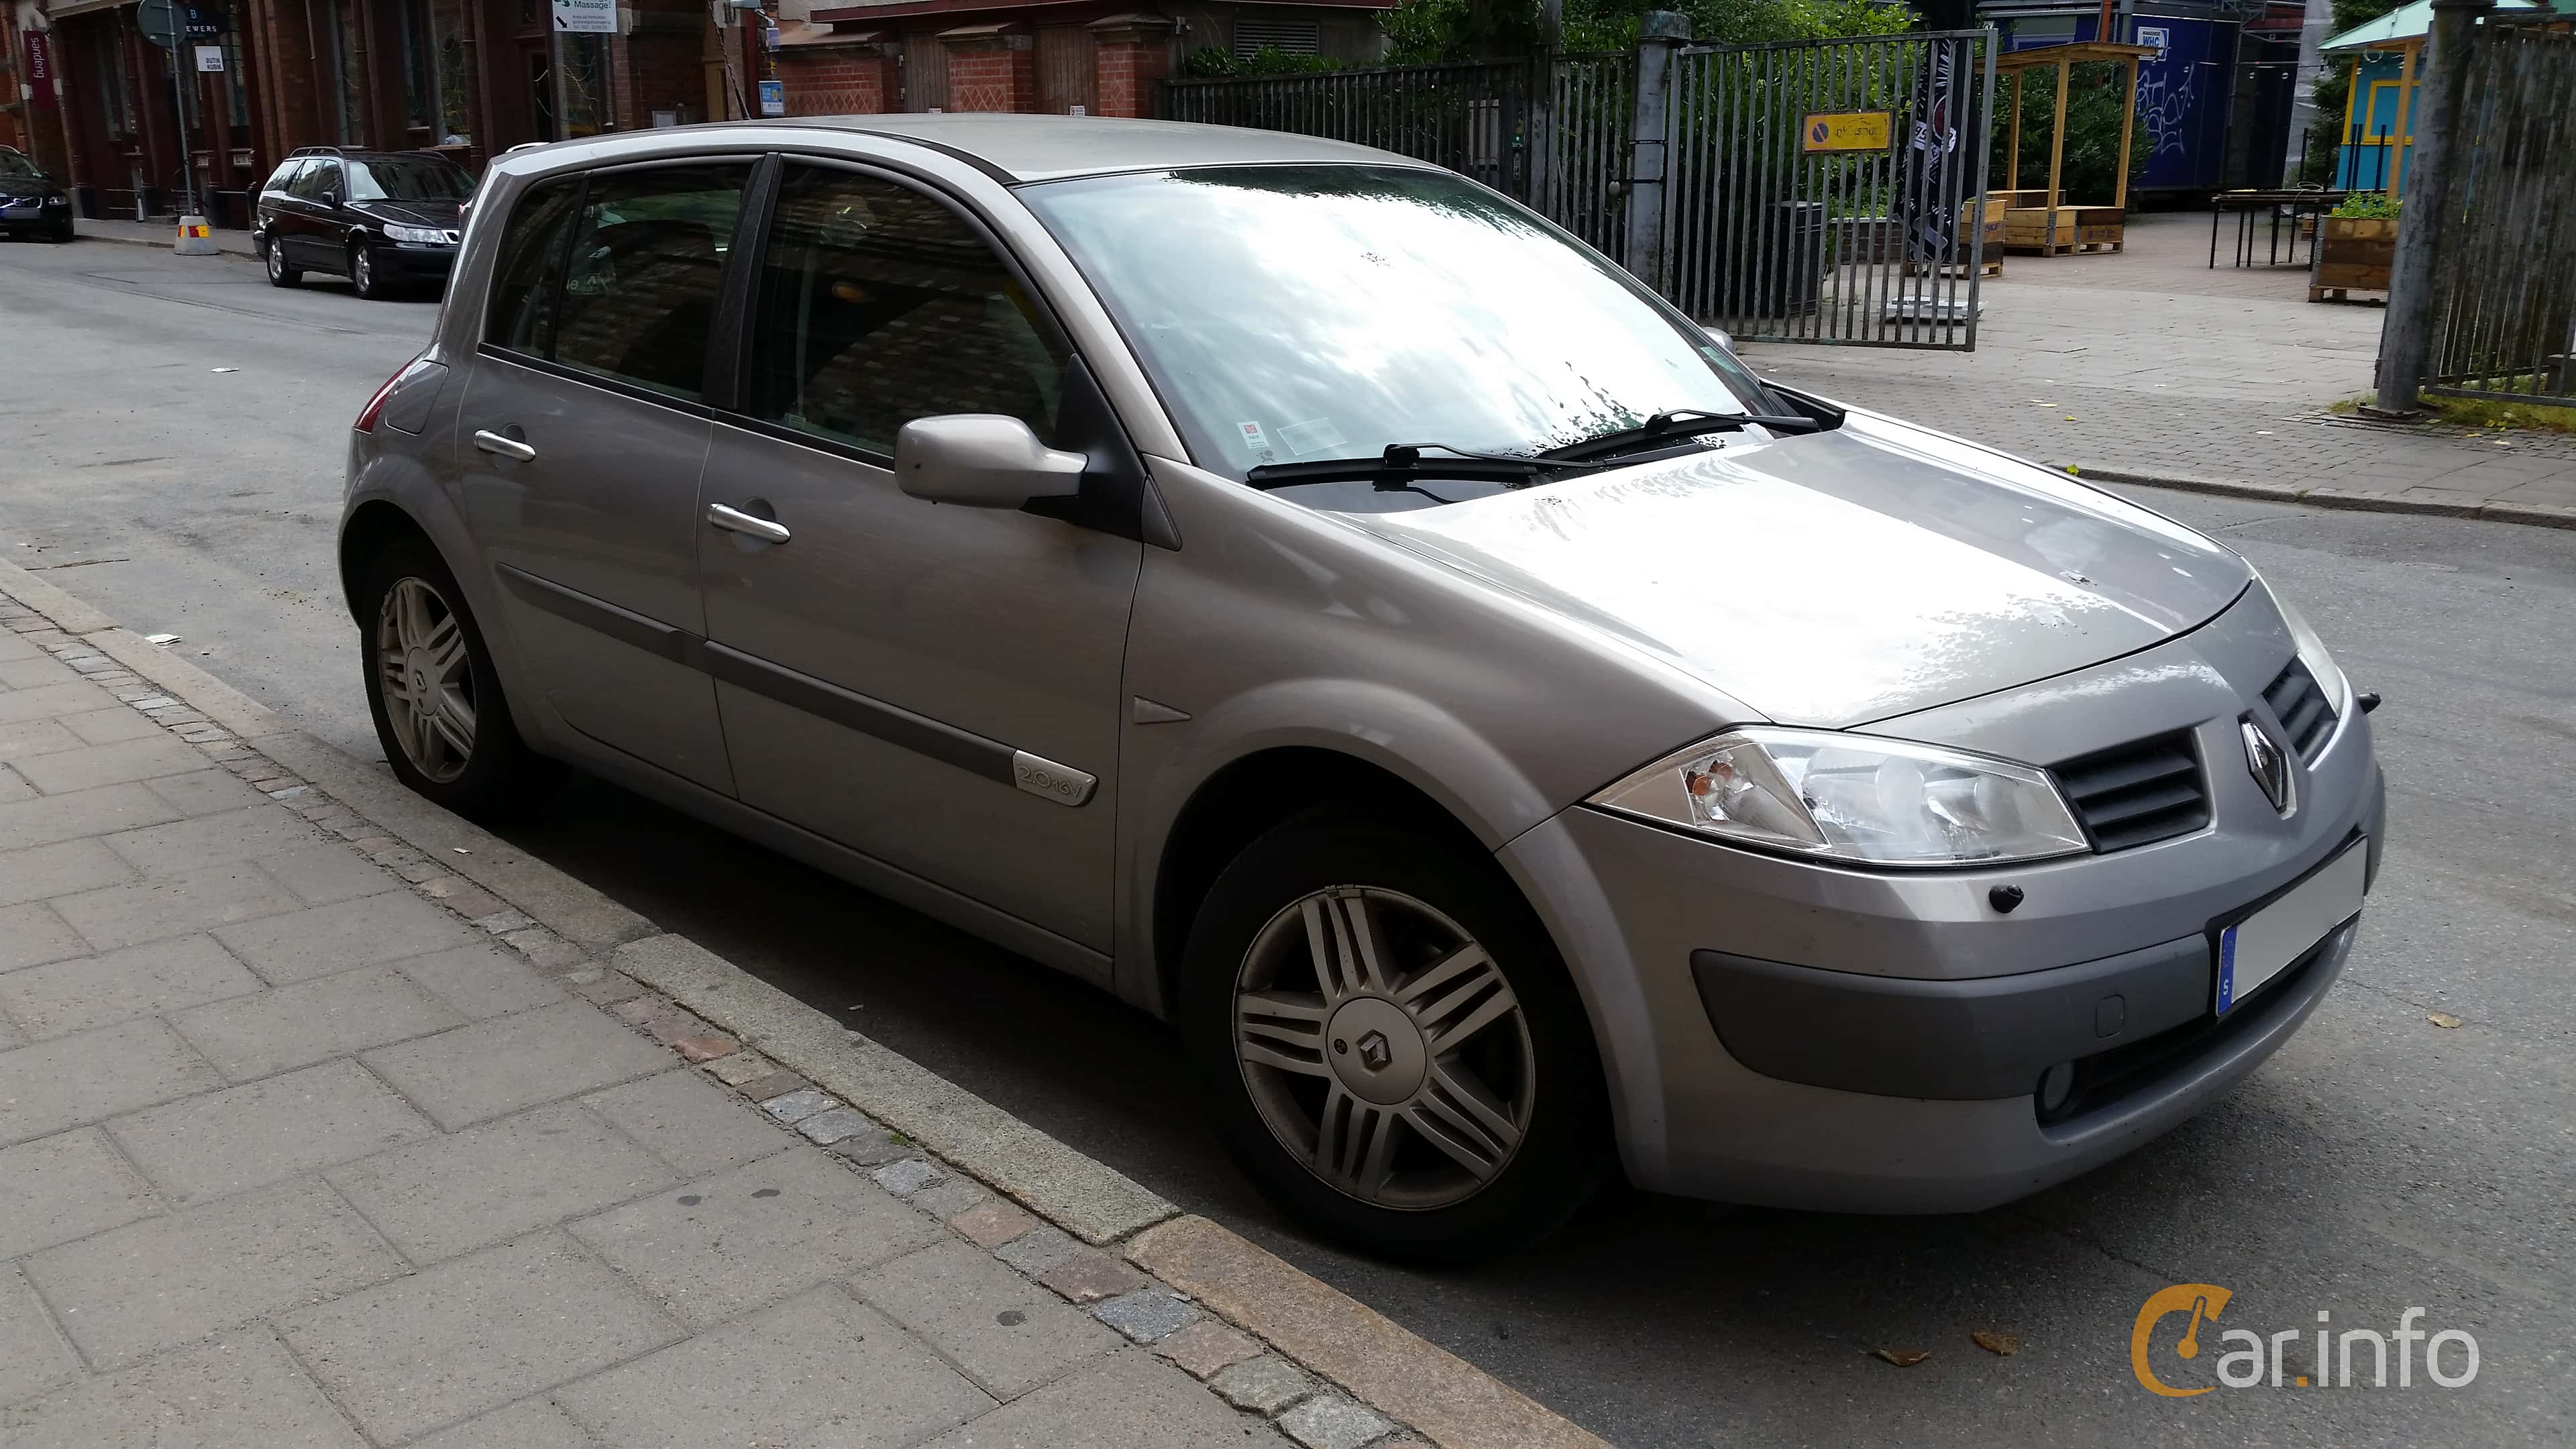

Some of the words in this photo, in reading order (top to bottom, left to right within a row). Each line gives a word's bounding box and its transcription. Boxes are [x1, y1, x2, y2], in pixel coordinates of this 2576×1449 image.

[190, 9, 197, 19] B
[32, 38, 45, 78] sandeng
[2222, 978, 2229, 996] S
